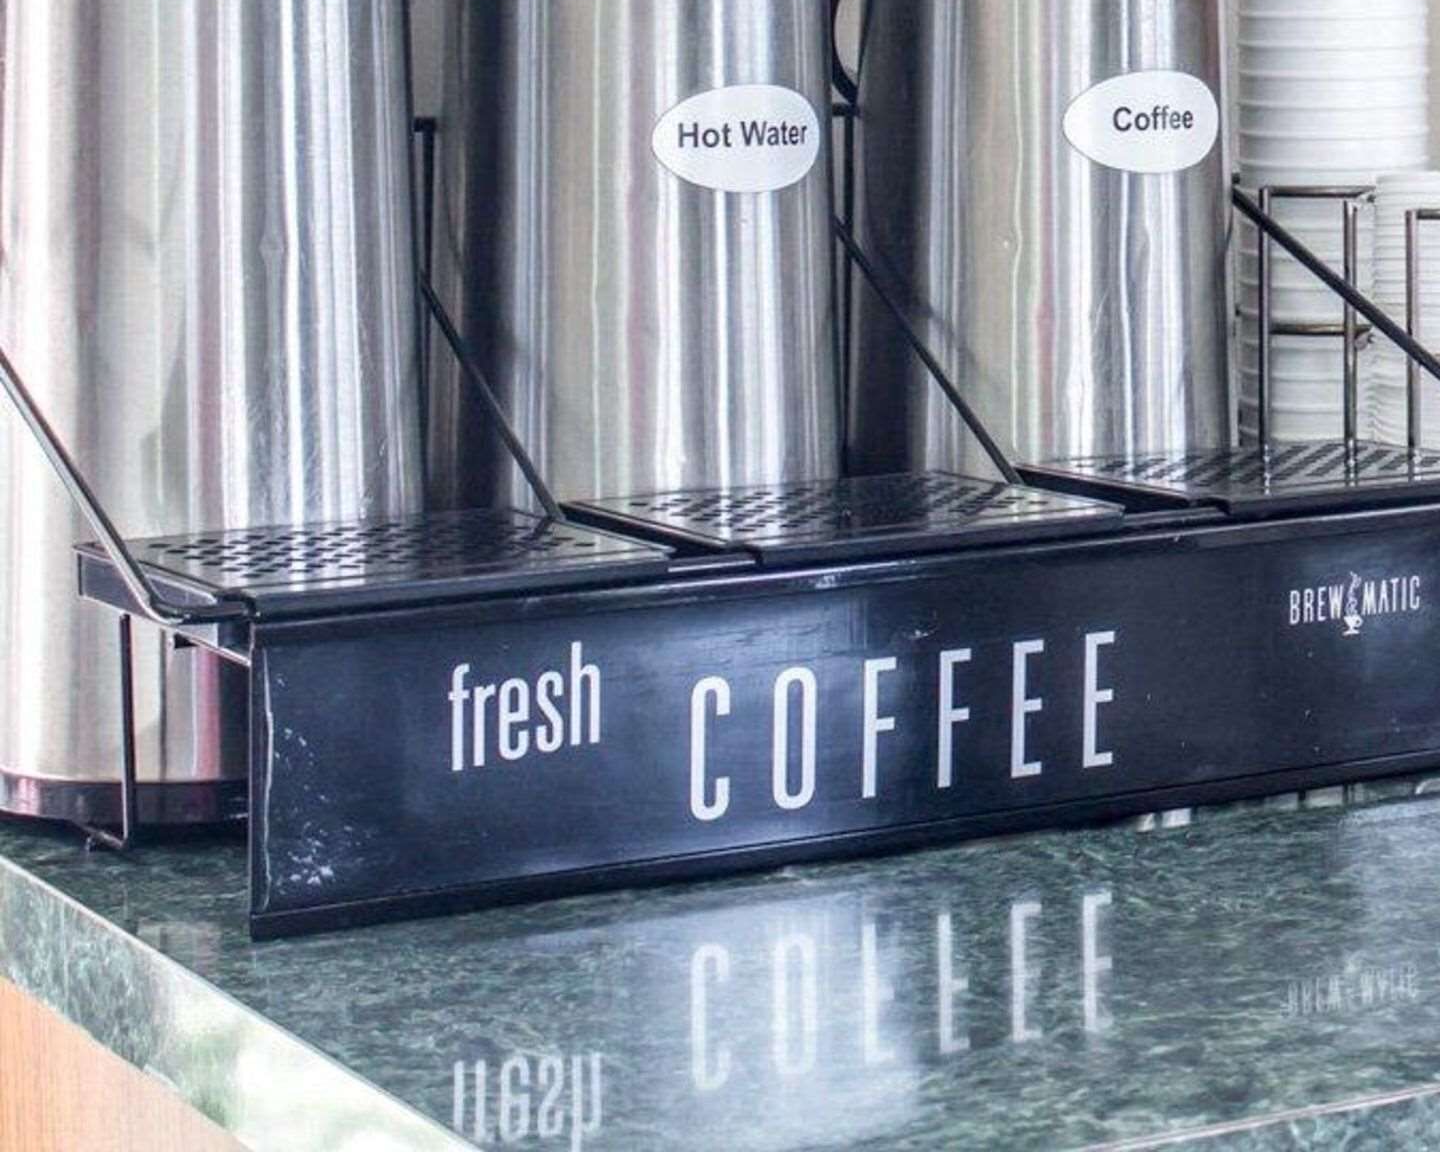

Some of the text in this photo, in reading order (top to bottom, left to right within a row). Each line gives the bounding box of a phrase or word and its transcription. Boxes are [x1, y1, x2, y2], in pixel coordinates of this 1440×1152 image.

[678, 120, 808, 149] Hot Water
[1113, 105, 1194, 132] Coffee
[1289, 575, 1421, 625] BREW MATIC
[448, 630, 1115, 822] fresh COFFEE
